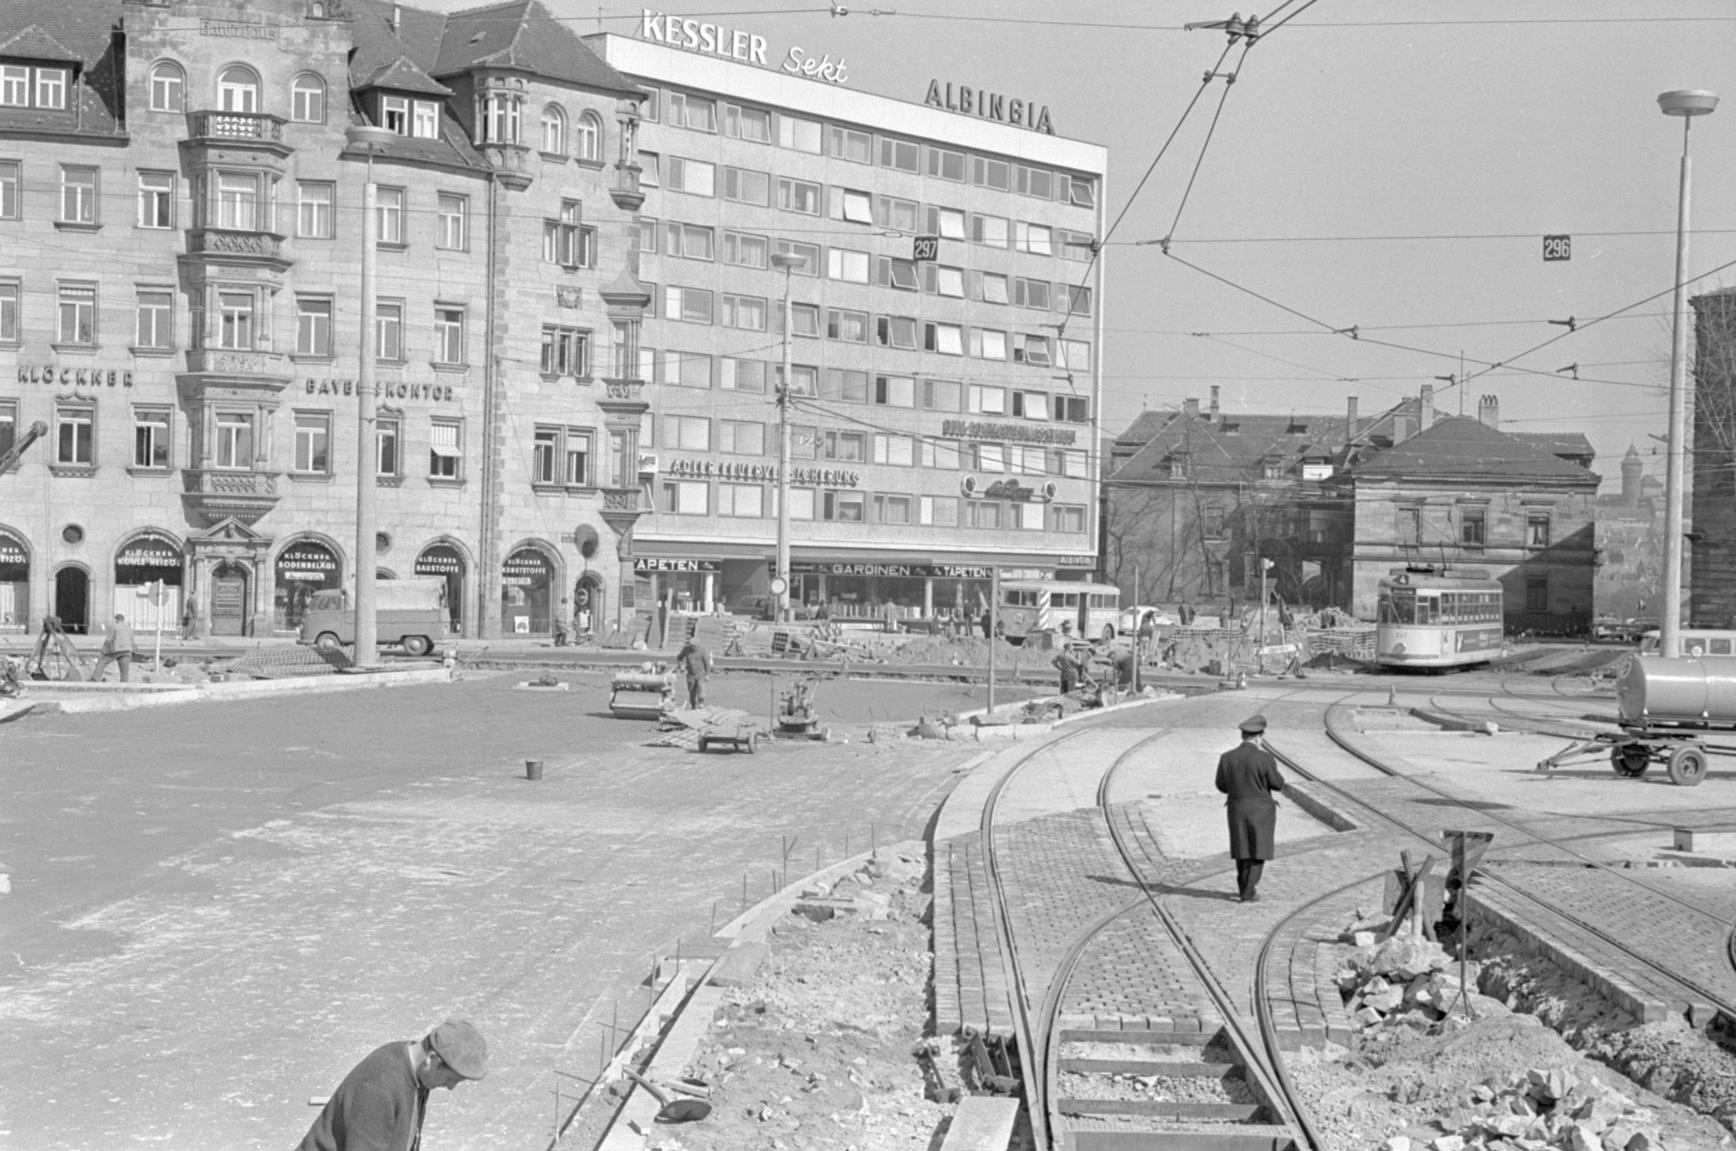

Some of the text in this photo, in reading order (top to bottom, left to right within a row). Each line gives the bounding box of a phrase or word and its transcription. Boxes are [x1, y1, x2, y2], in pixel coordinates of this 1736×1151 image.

[642, 9, 848, 83] KESSLER Sekt
[924, 79, 1055, 135] ALBINGIA
[915, 240, 937, 258] 297
[1545, 239, 1569, 257] 296
[18, 365, 133, 387] KLÖCKNER
[671, 458, 714, 477] ADLER
[719, 462, 860, 487] FEUERVESICHERUNG
[125, 548, 172, 557] KLÖCKNER
[284, 552, 330, 561] KLÖCKNER
[278, 560, 337, 570] BODENBELÄGE
[418, 555, 457, 564] KLÖCKNER
[508, 557, 541, 566] KLÖCKNER
[634, 558, 698, 571] APETEN
[416, 564, 459, 573] BAUSTOFFE
[502, 567, 546, 575] KUNSTSTOFFE
[832, 564, 910, 576] GARDINEN
[944, 566, 986, 577] TAPETEN
